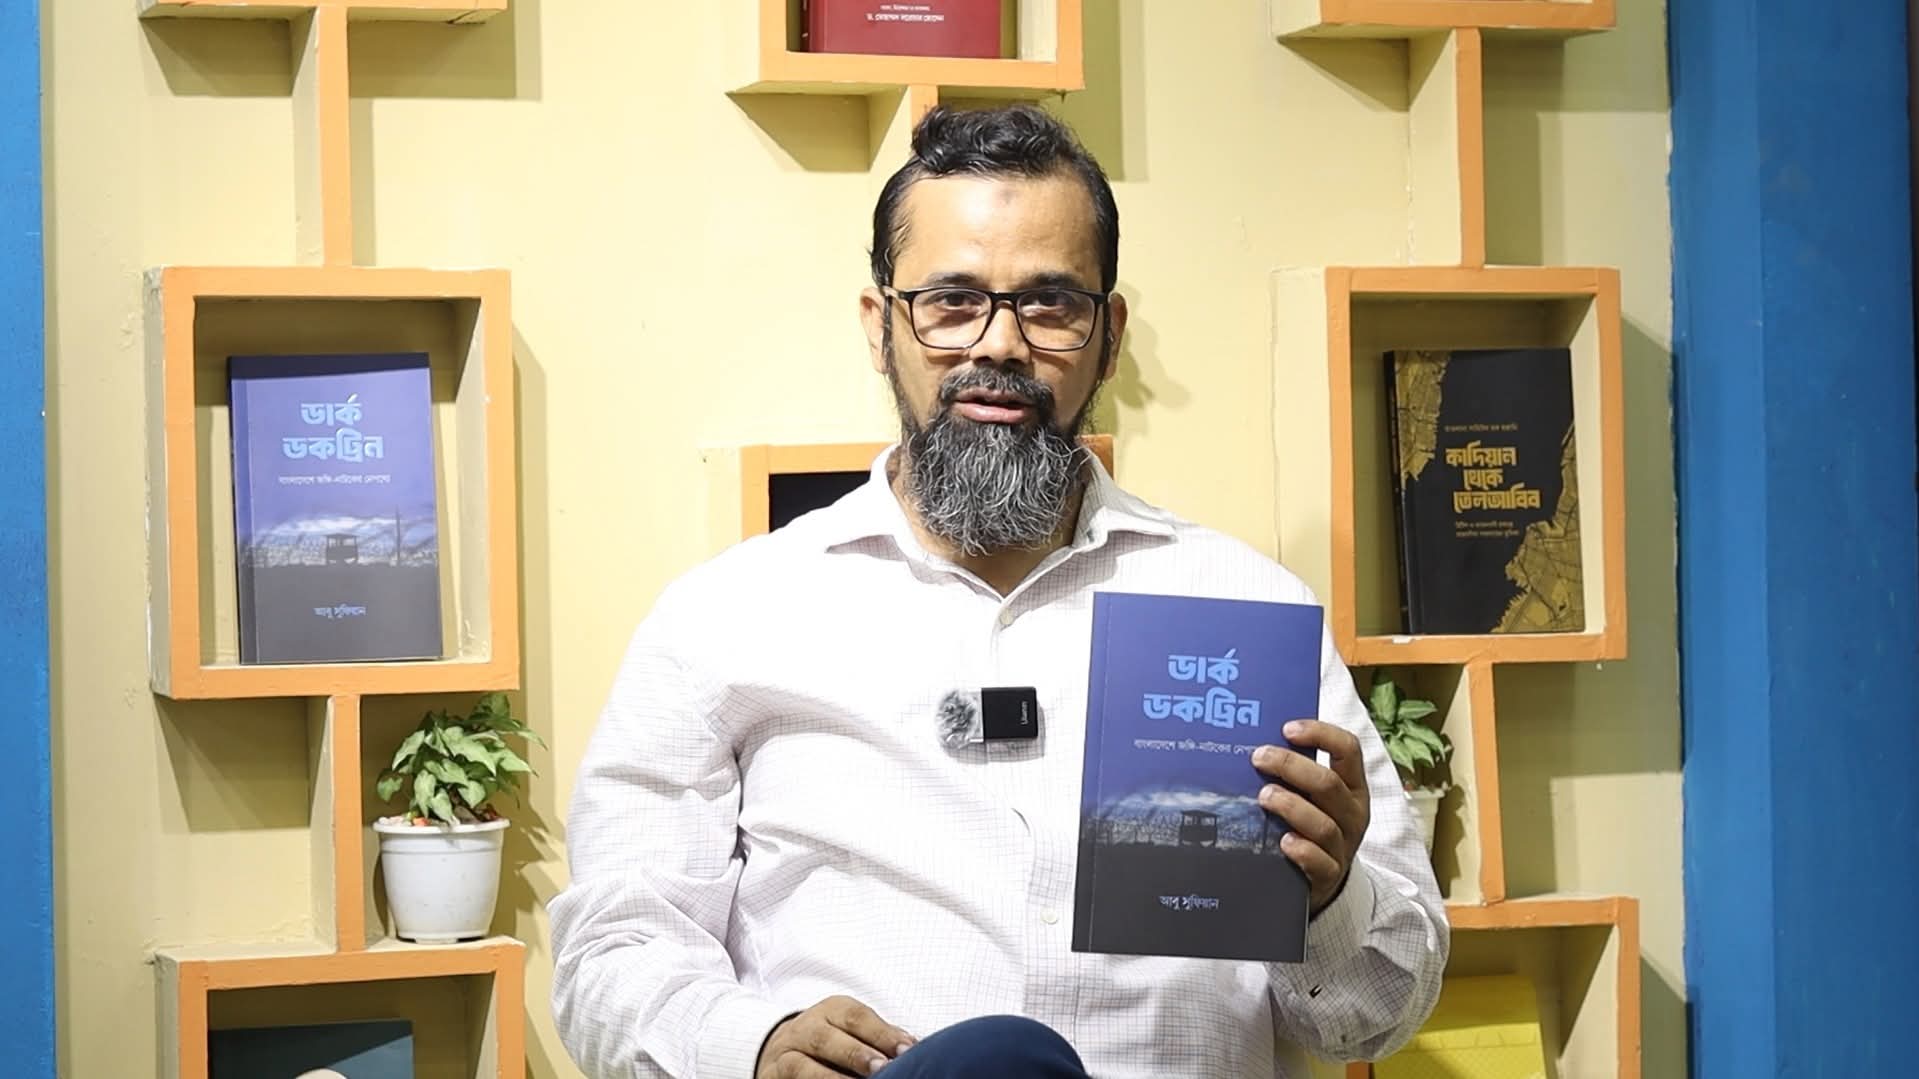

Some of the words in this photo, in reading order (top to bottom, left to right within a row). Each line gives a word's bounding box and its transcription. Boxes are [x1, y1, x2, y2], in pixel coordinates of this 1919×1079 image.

[300, 393, 362, 427] ডার্ক
[281, 427, 385, 463] ডকট্রিন
[1445, 439, 1517, 468] কাদিয়ান
[1463, 468, 1504, 490] থেকে
[1453, 481, 1541, 514] তেলআবিব
[1167, 647, 1241, 685] ডার্ক
[1143, 686, 1261, 729] ডকট্রিন
[1133, 738, 1176, 751] বাংলাদেশে
[1159, 894, 1180, 910] আবু
[1181, 893, 1220, 910] সুফিয়ান
